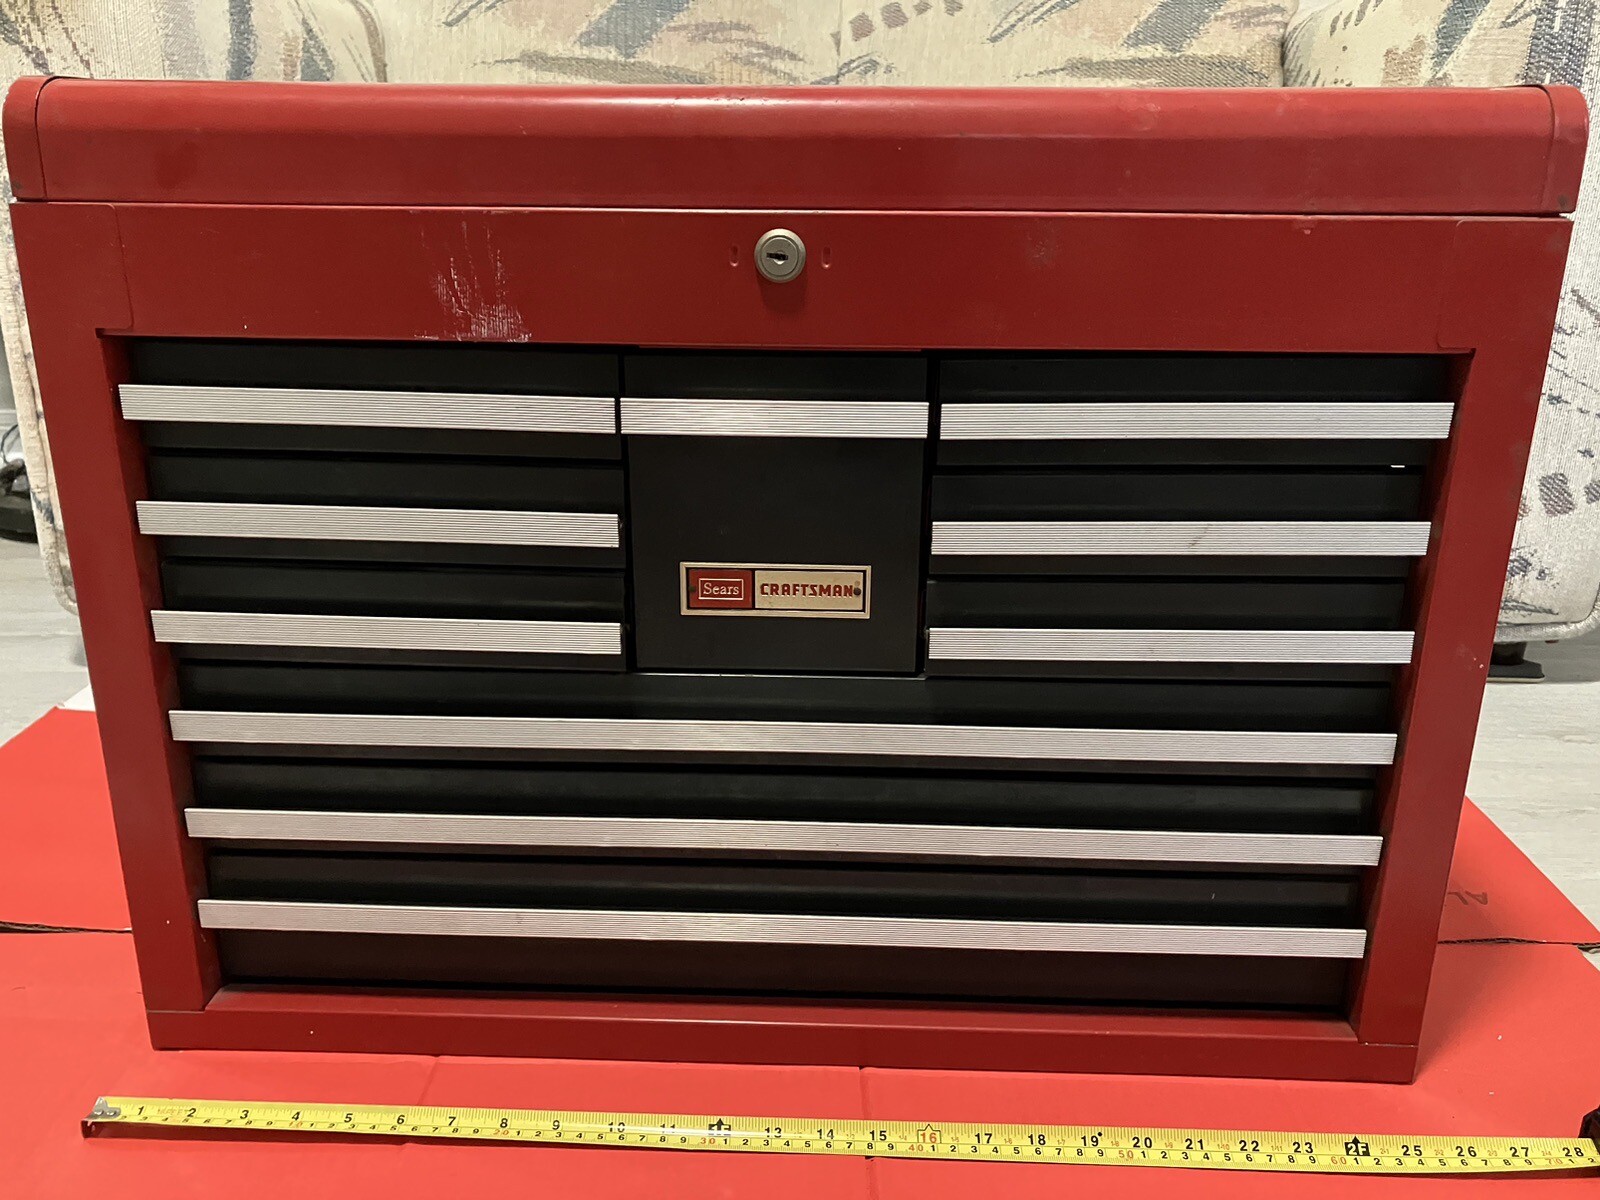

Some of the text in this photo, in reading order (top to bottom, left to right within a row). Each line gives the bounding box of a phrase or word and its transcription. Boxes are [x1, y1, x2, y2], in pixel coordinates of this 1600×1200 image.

[703, 582, 853, 598] Sears CRAFTSMAN
[137, 1106, 144, 1116] 1
[187, 1108, 196, 1117] 2
[240, 1110, 249, 1119] 3
[292, 1112, 301, 1121] 4
[344, 1113, 353, 1122] 5
[397, 1115, 406, 1125] 6
[448, 1116, 456, 1126] 7
[500, 1118, 508, 1128] 8
[552, 1120, 560, 1130] 9
[817, 1129, 834, 1139] 14
[870, 1130, 887, 1141] 15
[920, 1132, 937, 1143] 16
[975, 1133, 992, 1144] 17
[1028, 1134, 1046, 1145] 18
[1081, 1136, 1099, 1147] 19
[1132, 1137, 1153, 1149] 20
[1185, 1138, 1204, 1150] 21
[1239, 1140, 1260, 1152] 22
[1293, 1142, 1313, 1154] 23
[1347, 1143, 1367, 1156] 2F
[1401, 1145, 1423, 1157] 25
[1455, 1146, 1477, 1157] 26
[1509, 1146, 1529, 1158] 27
[1562, 1147, 1584, 1157] 28
[992, 1146, 999, 1154] 4
[1097, 1149, 1104, 1157] 9
[1119, 1151, 1133, 1159] 50
[1161, 1151, 1168, 1159] 2
[1224, 1153, 1231, 1161] 5
[1246, 1154, 1253, 1162] 6
[1288, 1155, 1295, 1163] 8
[1309, 1156, 1316, 1164] 9
[1331, 1156, 1347, 1164] 60
